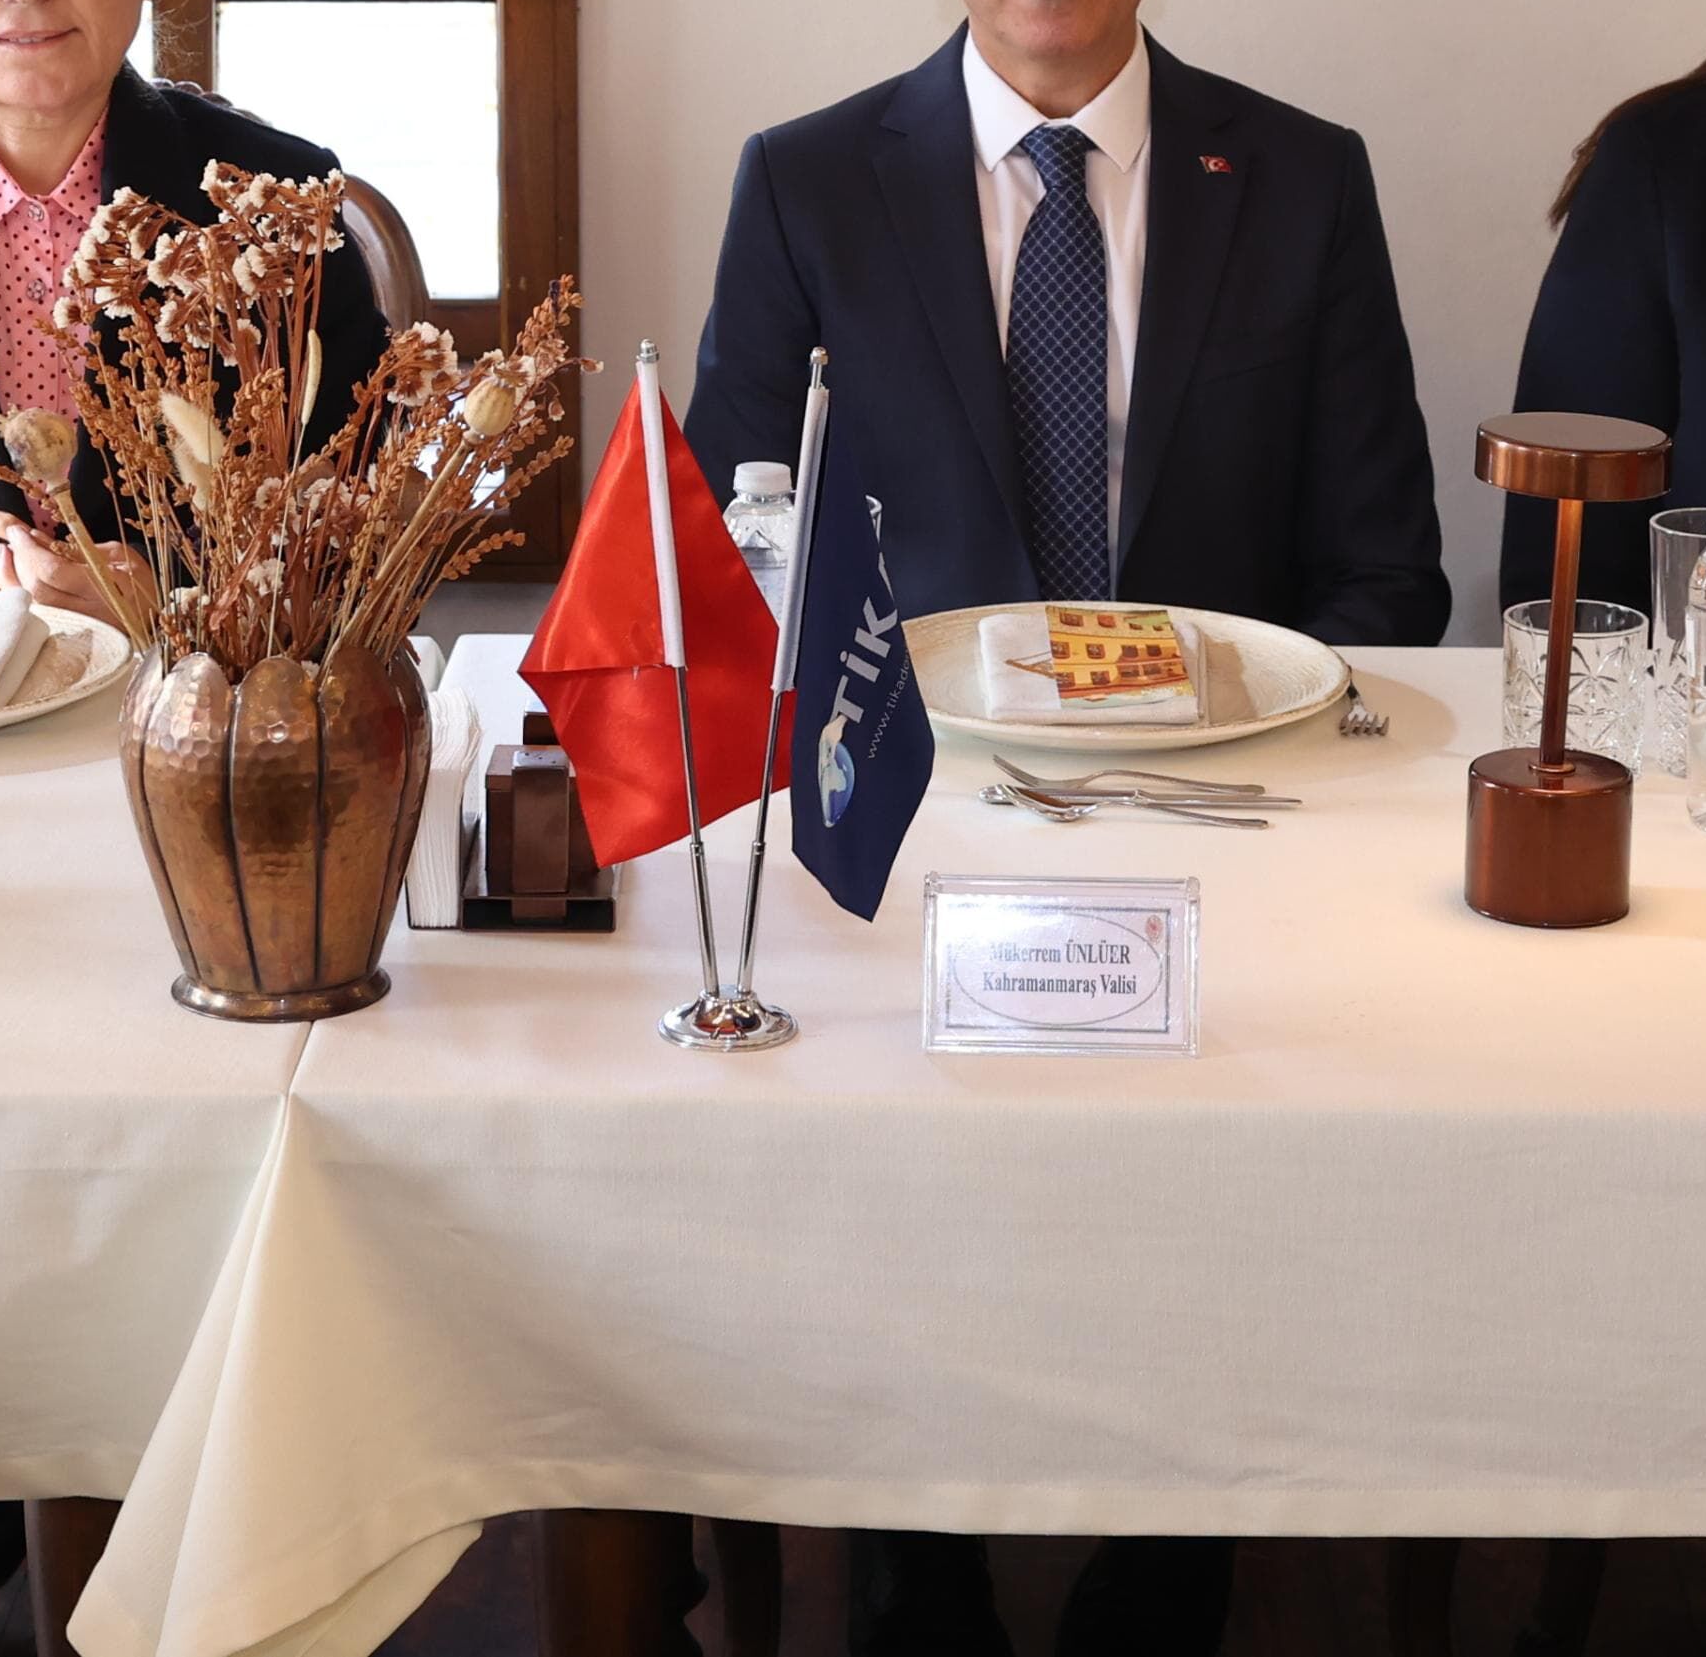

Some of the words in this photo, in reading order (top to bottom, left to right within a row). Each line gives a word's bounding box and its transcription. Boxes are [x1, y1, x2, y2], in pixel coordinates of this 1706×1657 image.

[989, 942, 1062, 963] Mükerrem
[1065, 939, 1131, 965] ÜNLÜER
[982, 971, 1097, 999] Kahramanmaraş
[1100, 974, 1137, 995] Valisi
